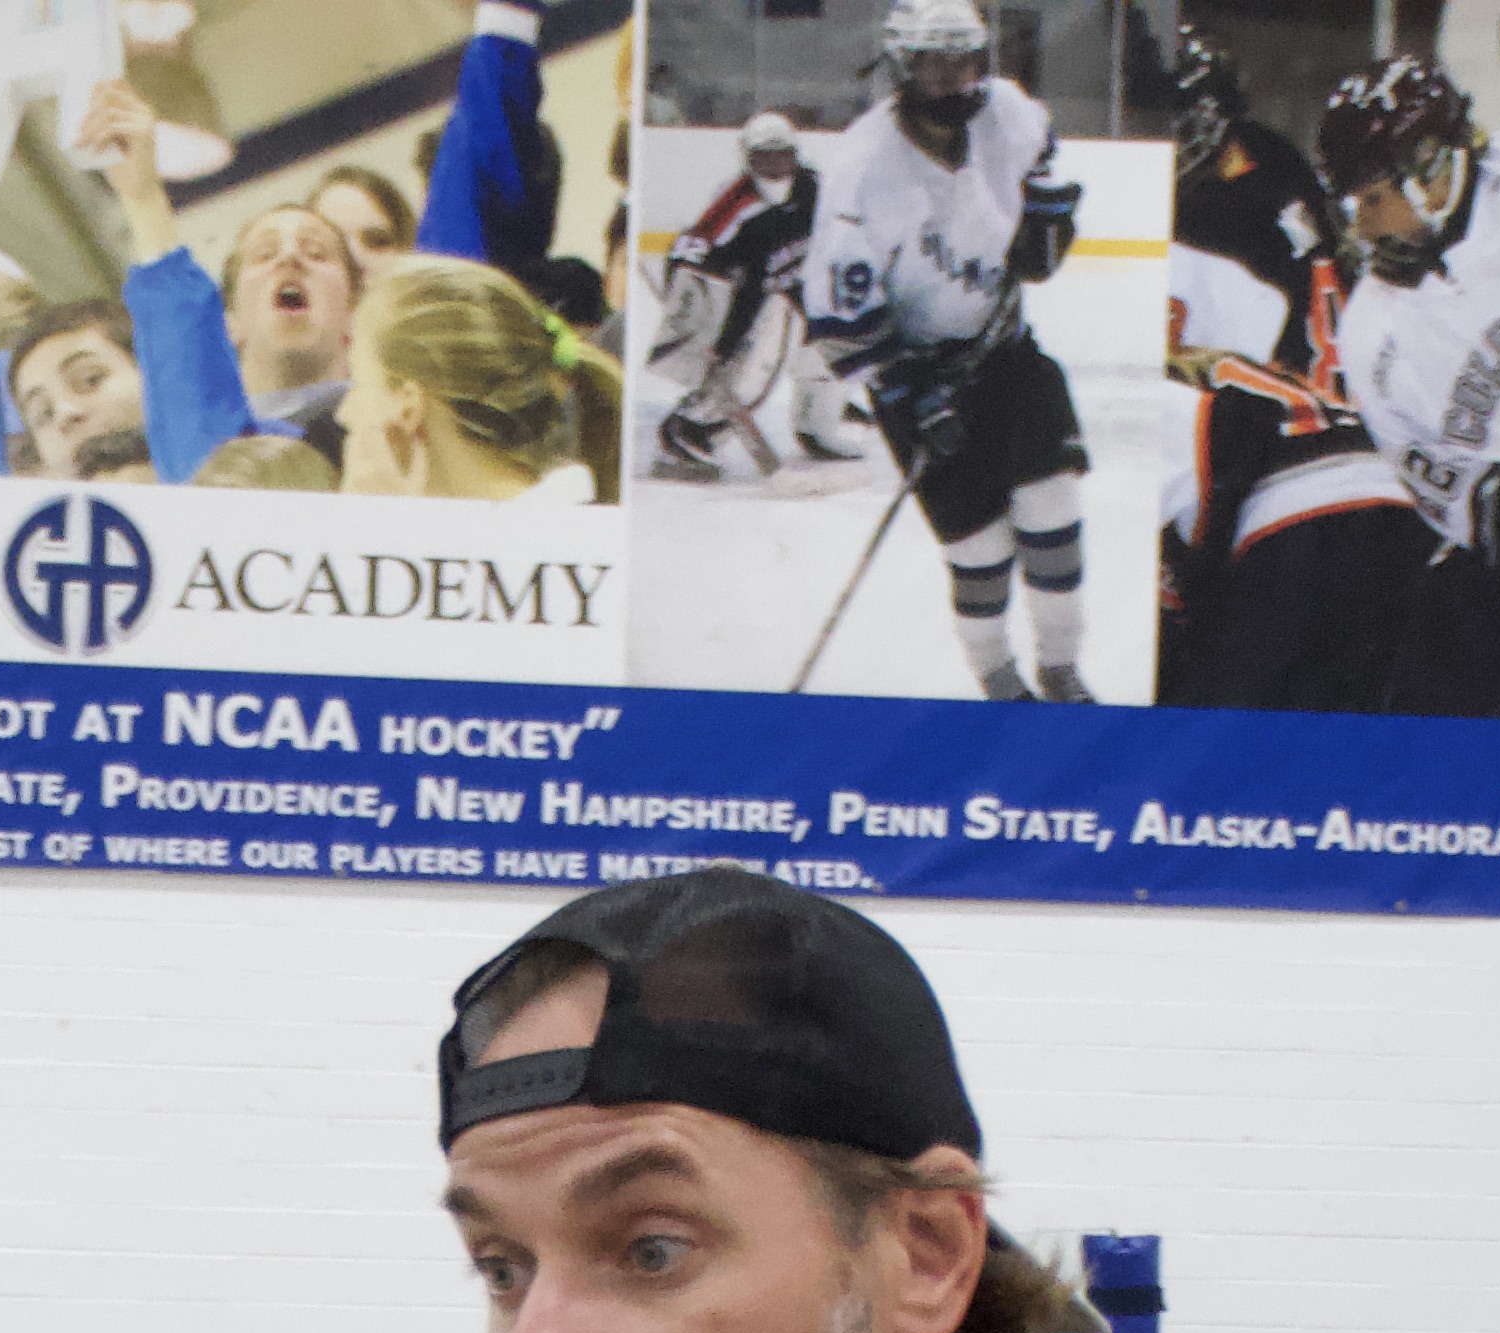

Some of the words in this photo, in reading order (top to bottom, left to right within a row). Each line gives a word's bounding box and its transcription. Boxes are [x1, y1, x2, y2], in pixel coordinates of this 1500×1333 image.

[173, 546, 613, 627] ACADEMY
[72, 702, 144, 743] AT
[163, 690, 360, 752] NCAA
[416, 774, 526, 823] NEW
[829, 790, 949, 839] PENN
